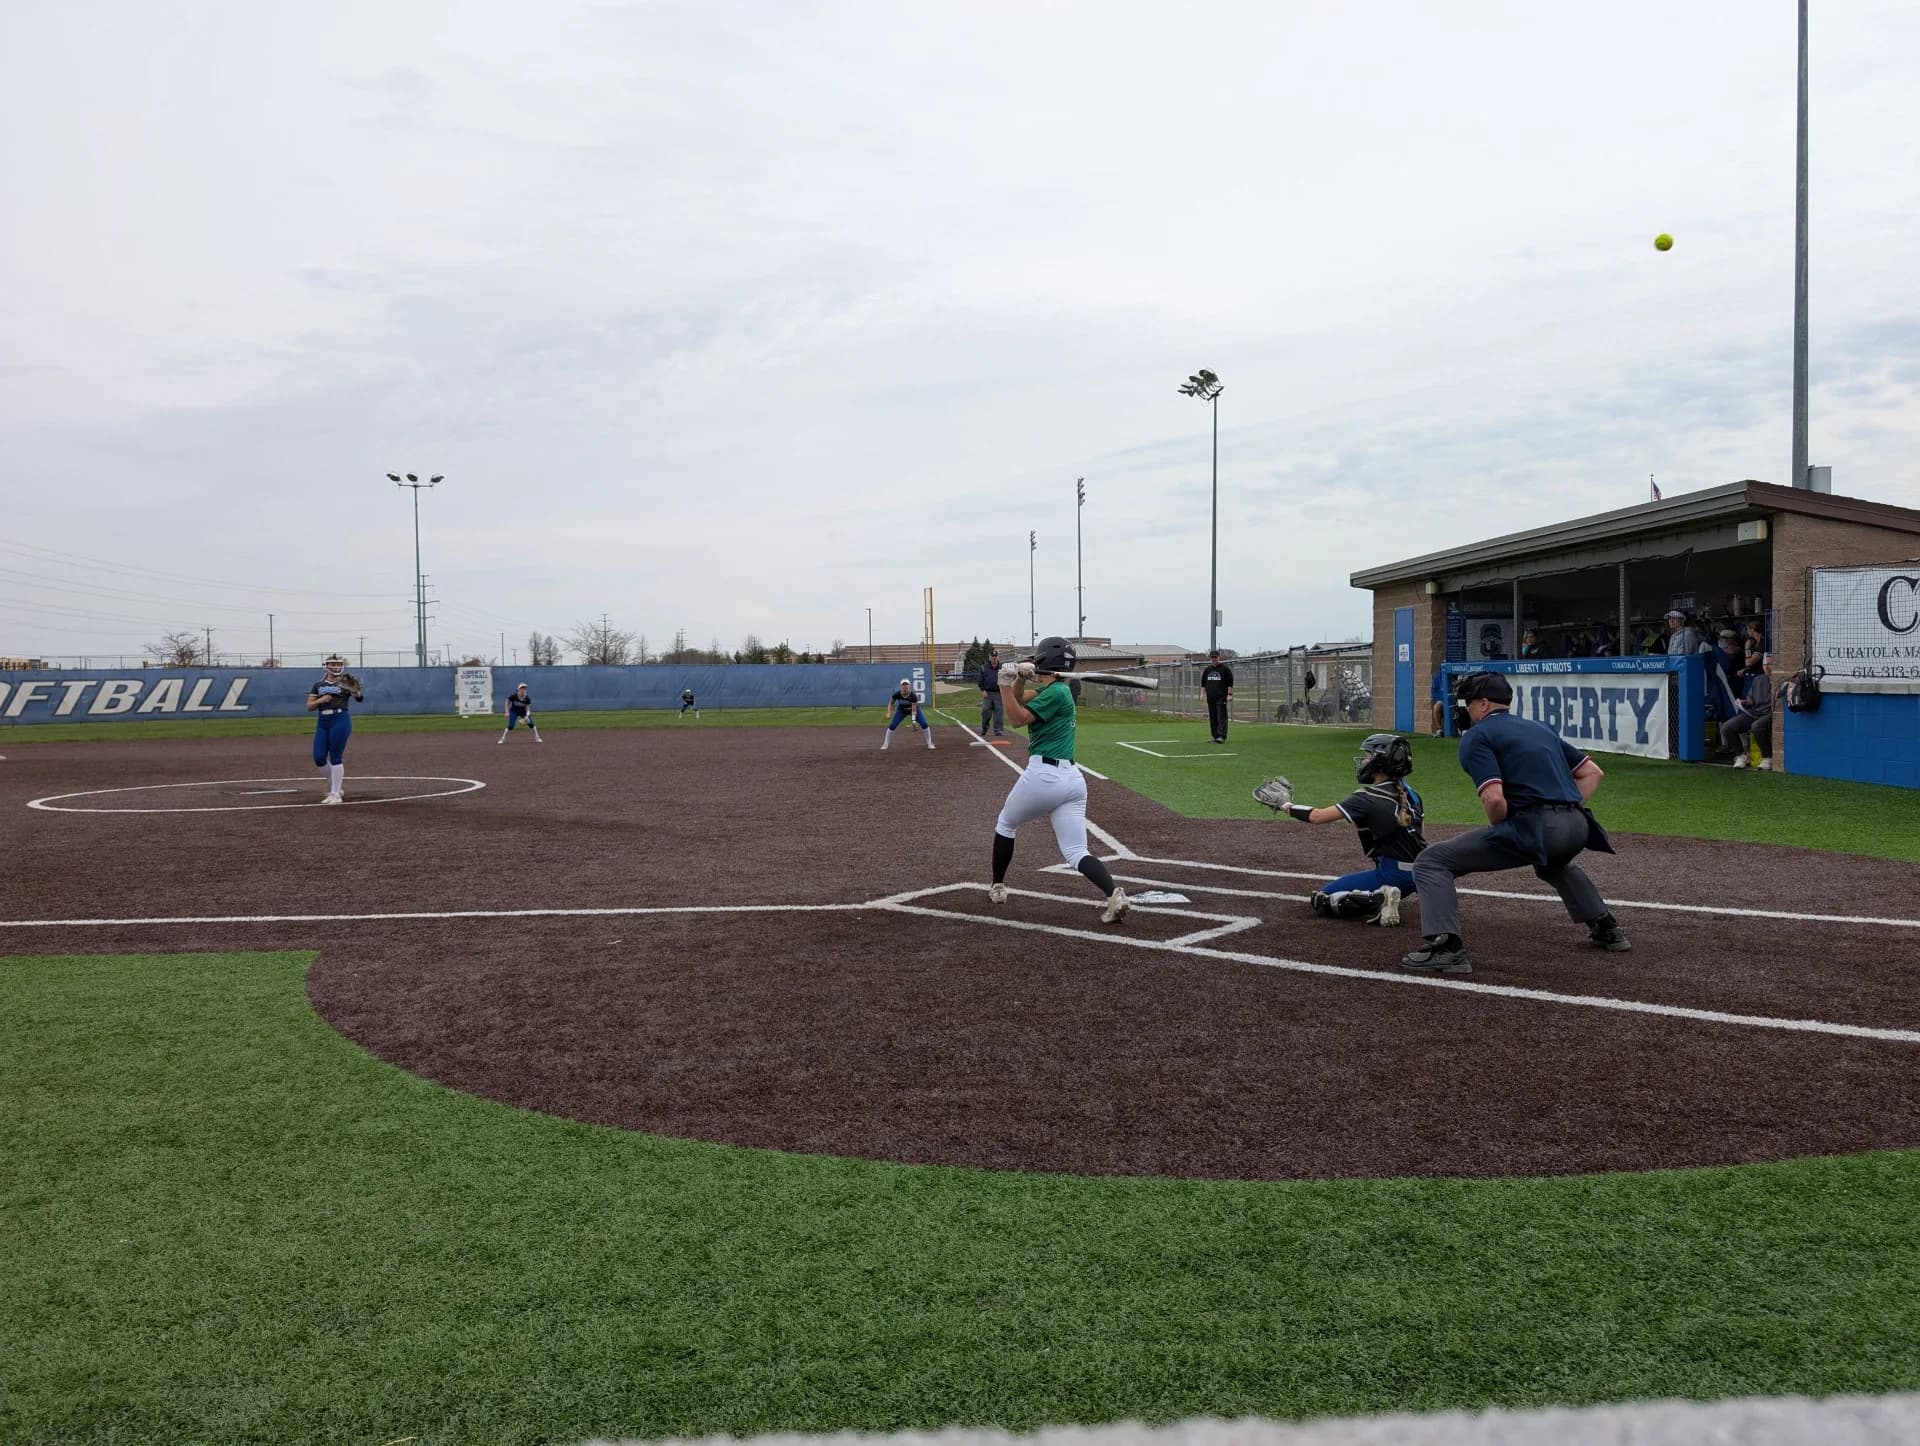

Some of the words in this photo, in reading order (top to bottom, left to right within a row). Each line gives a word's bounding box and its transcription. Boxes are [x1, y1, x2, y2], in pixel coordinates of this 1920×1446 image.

[1828, 647, 1901, 659] CURATOLA
[1515, 663, 1539, 673] LIBERTY
[1542, 661, 1572, 672] PATRIOTS
[0, 677, 251, 718] FTBALL
[912, 667, 926, 704] 200
